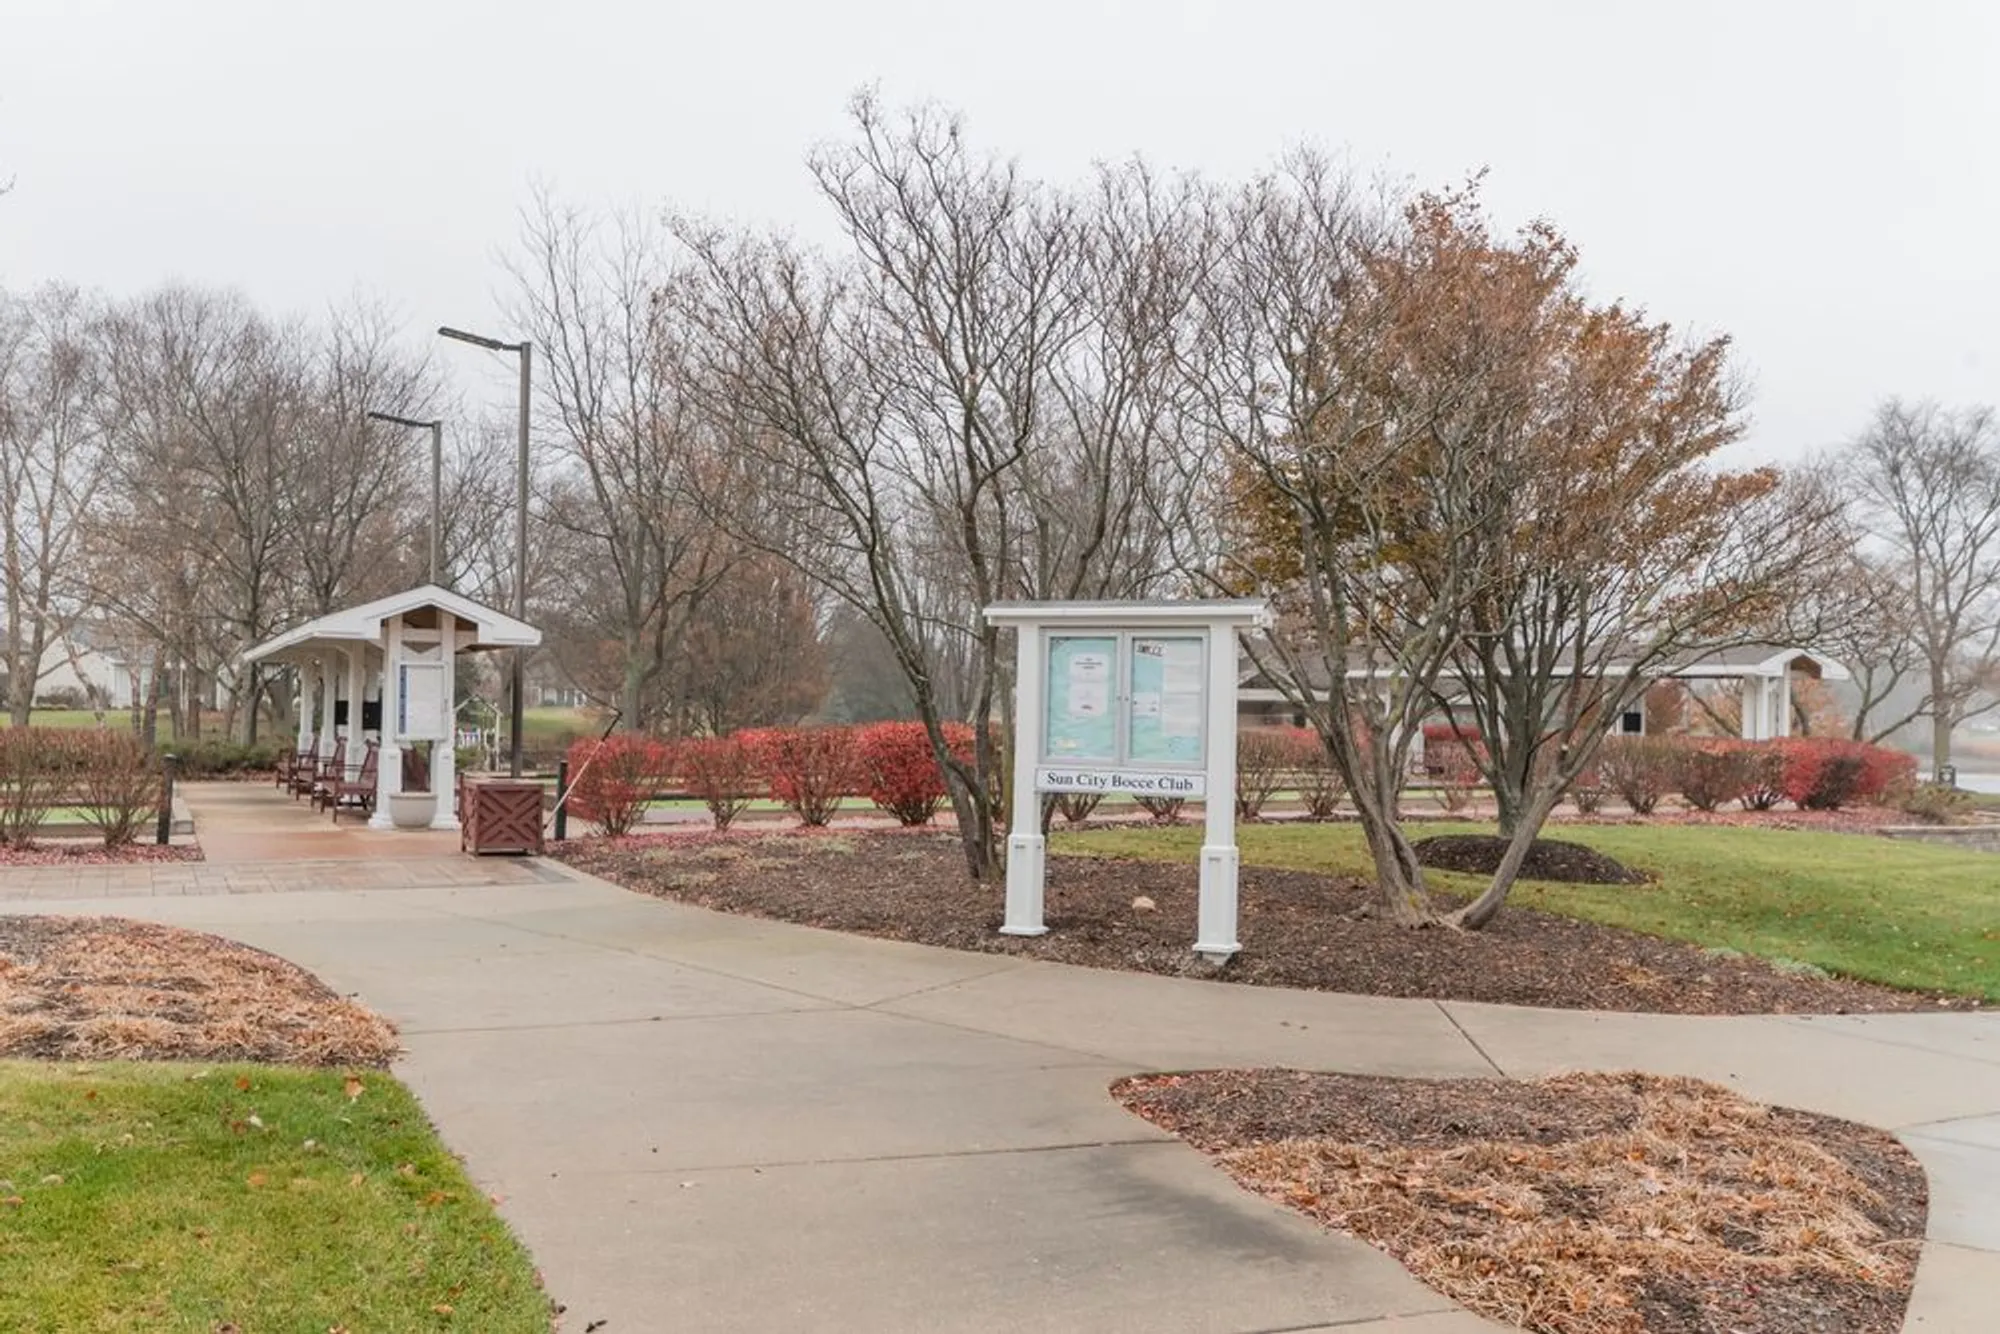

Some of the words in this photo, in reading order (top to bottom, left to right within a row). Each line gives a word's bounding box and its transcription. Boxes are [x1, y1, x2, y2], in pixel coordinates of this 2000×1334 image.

[1047, 773, 1073, 785] Sun
[1076, 774, 1108, 788] City
[1112, 775, 1154, 789] Bocce
[1158, 776, 1193, 791] Club
